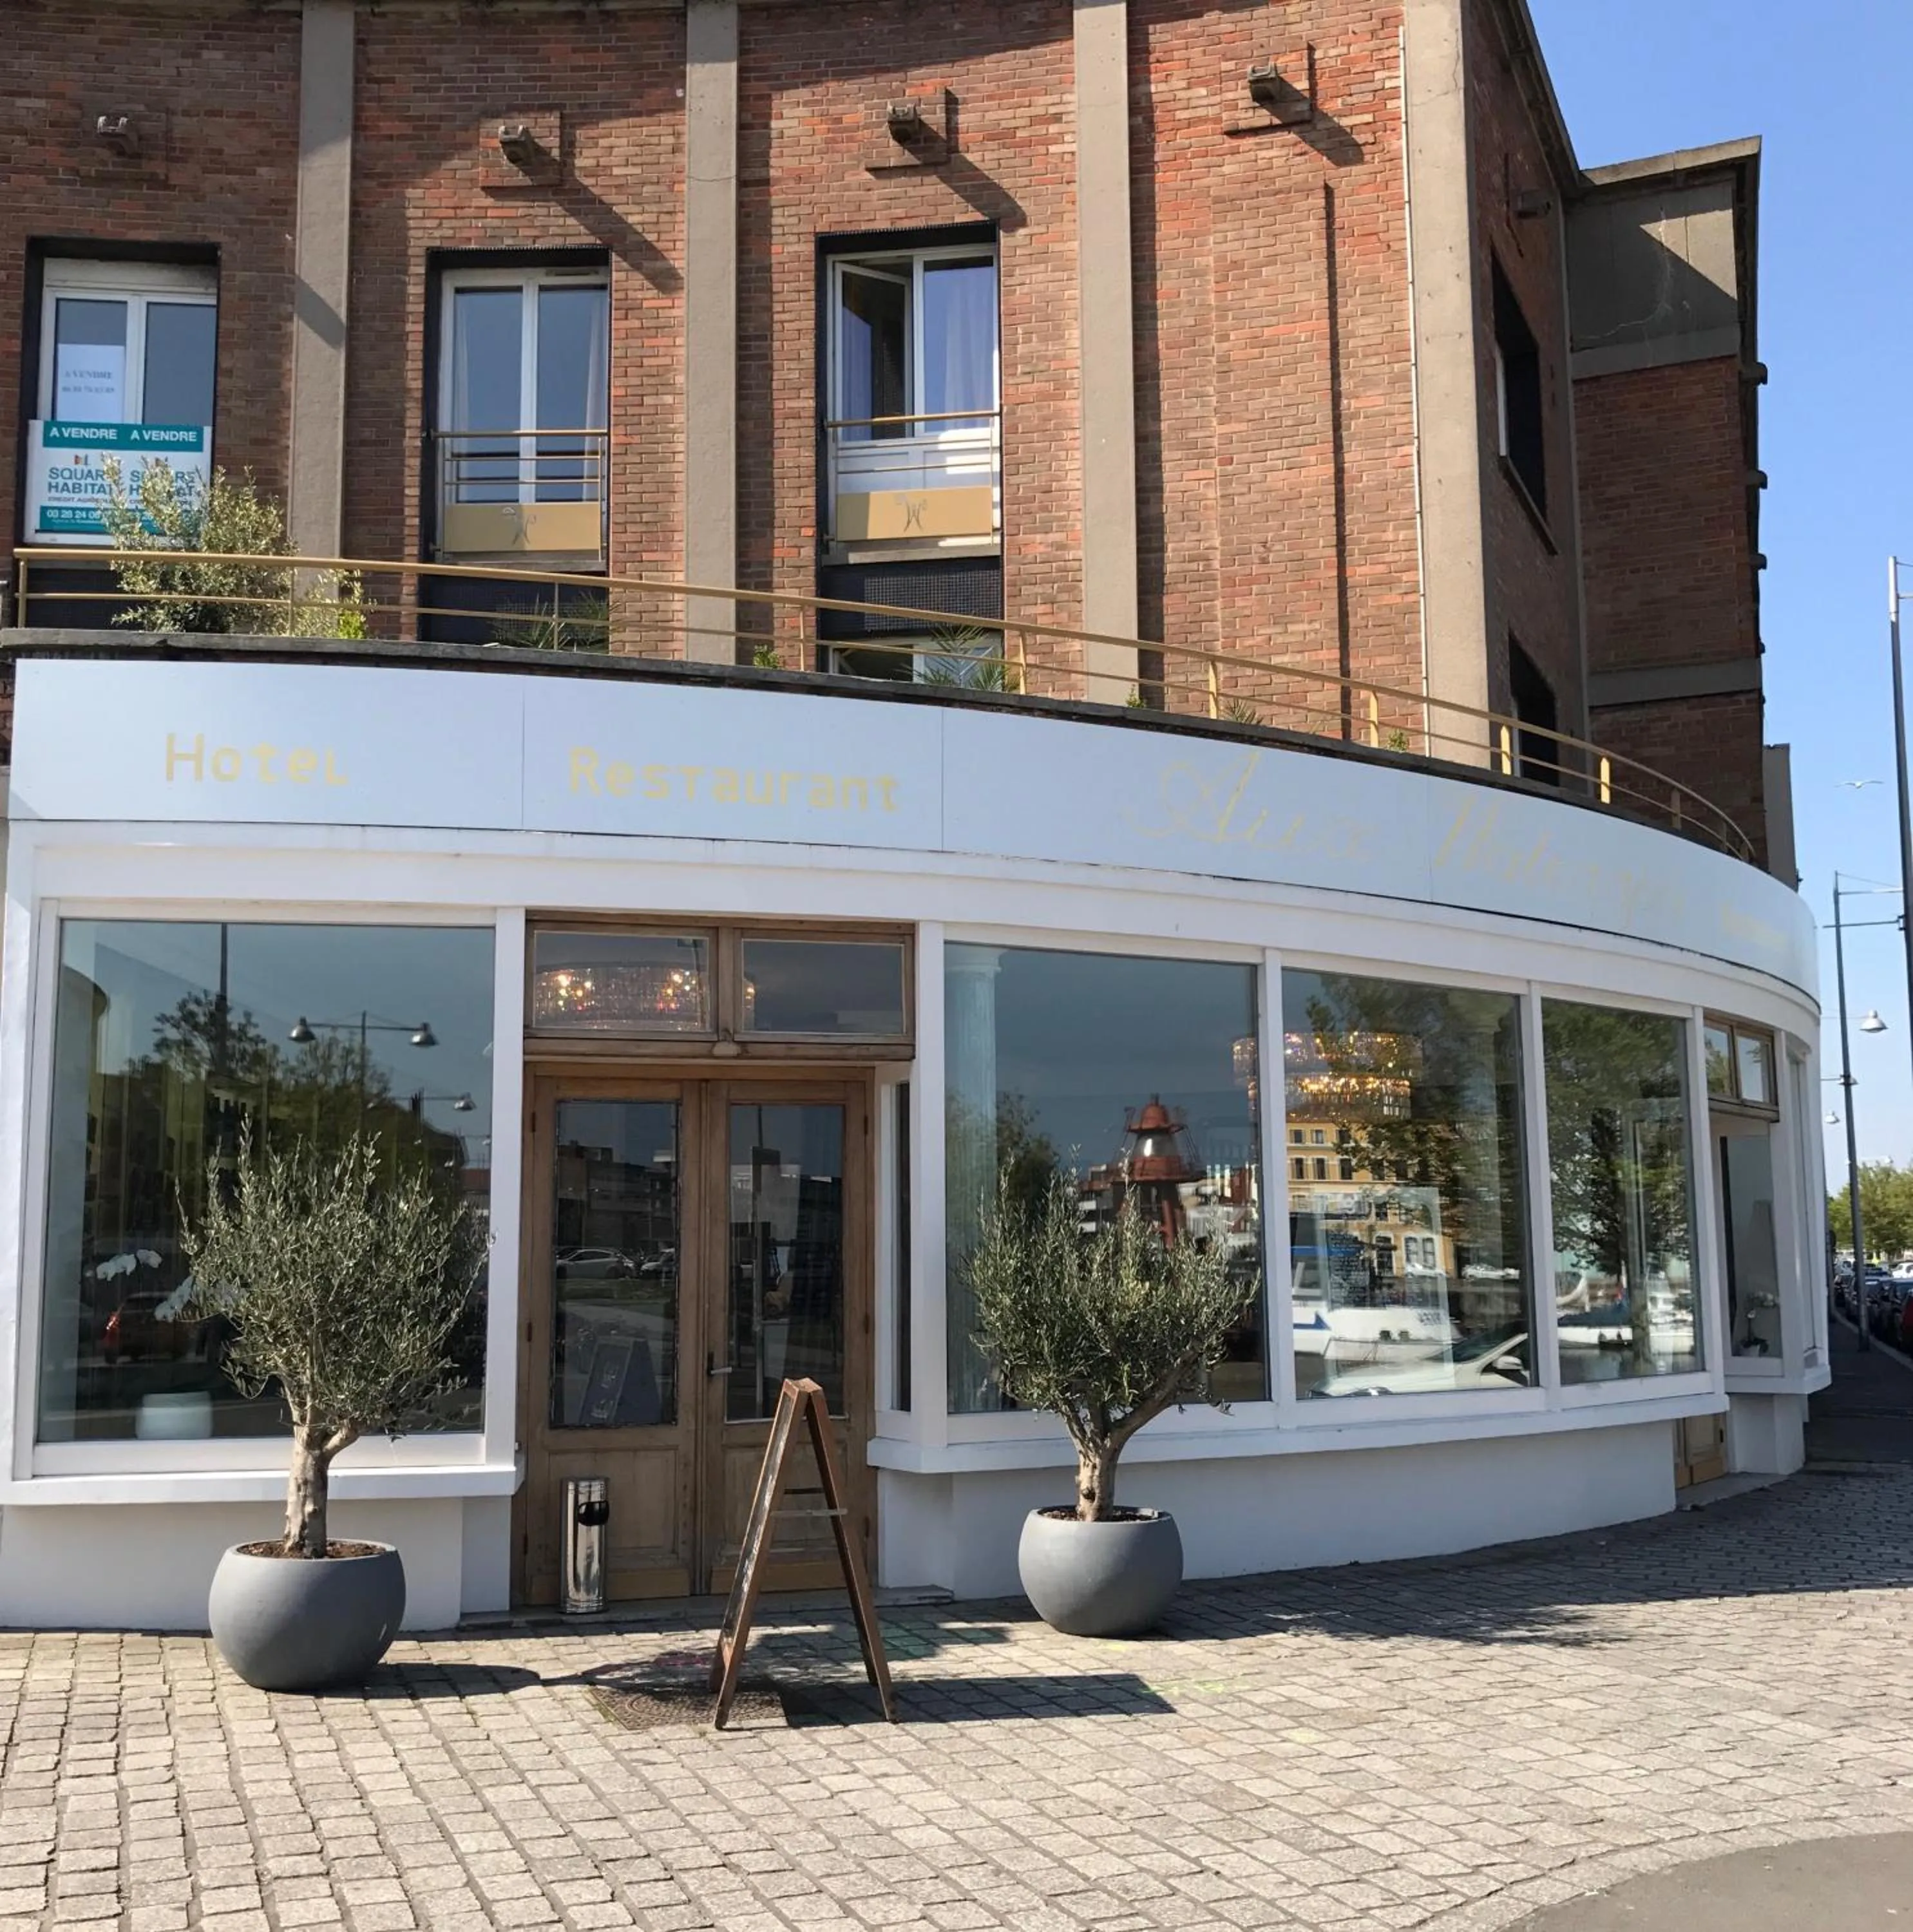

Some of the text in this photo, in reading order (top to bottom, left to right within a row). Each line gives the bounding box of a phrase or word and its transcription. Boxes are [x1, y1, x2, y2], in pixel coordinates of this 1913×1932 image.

[50, 427, 118, 440] A VENDRE
[130, 430, 197, 442] A VENDRE
[48, 466, 106, 481] SQUAR
[569, 744, 900, 812] Restaurant
